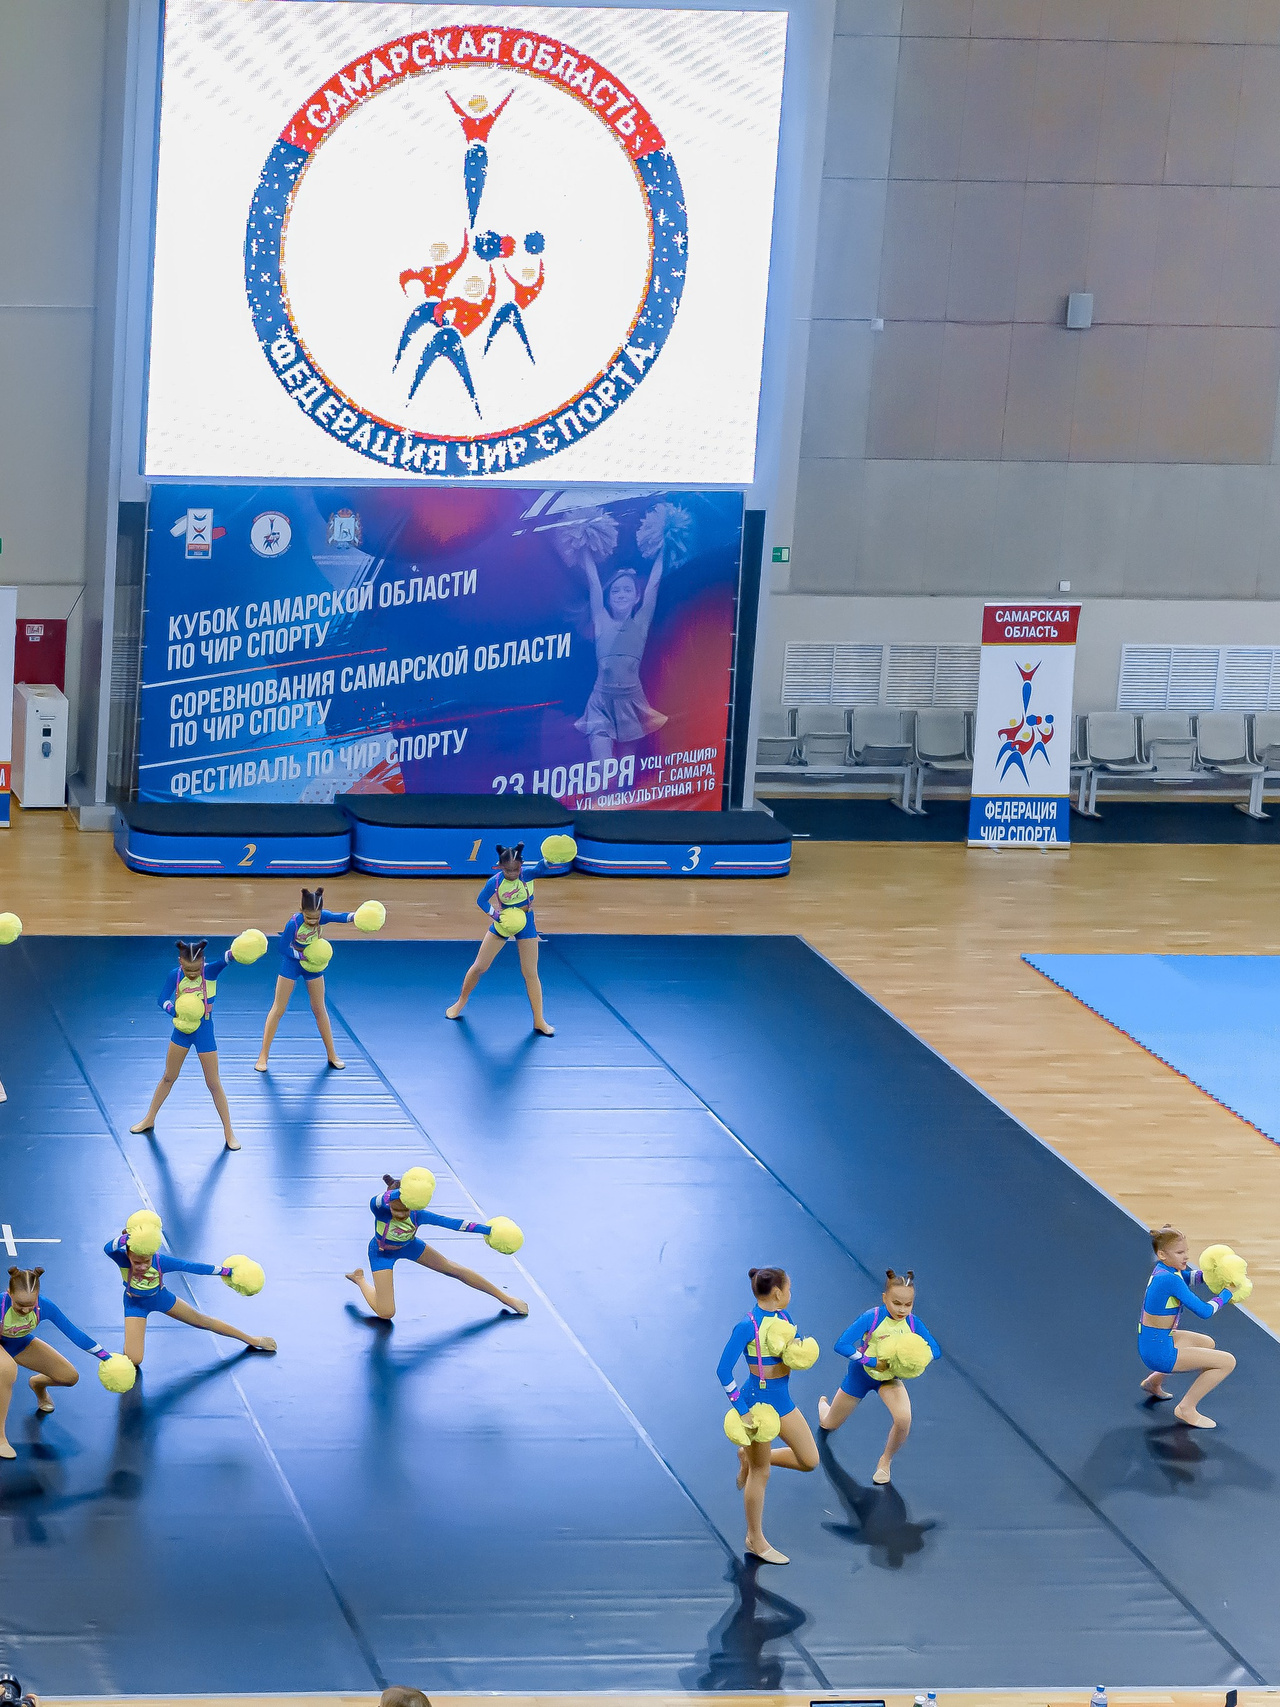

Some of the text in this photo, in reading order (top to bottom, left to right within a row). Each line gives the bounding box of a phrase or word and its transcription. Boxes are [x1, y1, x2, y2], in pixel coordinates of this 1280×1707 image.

[308, 31, 640, 136] САМАРСКАЯ ОБЛАСТЬ
[270, 337, 658, 474] ФЕДЕРАЦИЯ ЧИР СПОРТА
[168, 568, 478, 641] КУБОК САМАРСКОЙ ОБЛАСТИ
[995, 610, 1070, 623] САМАРСКАЯ
[1004, 625, 1058, 638] ОБЛАСТЬ
[167, 621, 331, 671] ПО ЧИР СПОРТУ
[170, 632, 571, 720] СОРЕВНОВАНИЯ САМАРСКОЙ ОБЛАСТИ
[170, 699, 333, 748] ПО ЧИР СПОРТУ
[170, 728, 469, 797] ФЕСТИВАЛЬ ПО ЧИР СПОРТУ
[640, 747, 718, 772] УСЦ «ГРАЦИЯ»
[492, 754, 636, 799] 23 НОЯБРЯ
[696, 777, 716, 793] 116
[984, 800, 1058, 824] ФЕДЕРАЦИЯ
[980, 825, 1058, 842] ЧИР СПОРТА
[237, 843, 257, 866] 2
[467, 838, 482, 862] 1
[681, 845, 702, 872] 3
